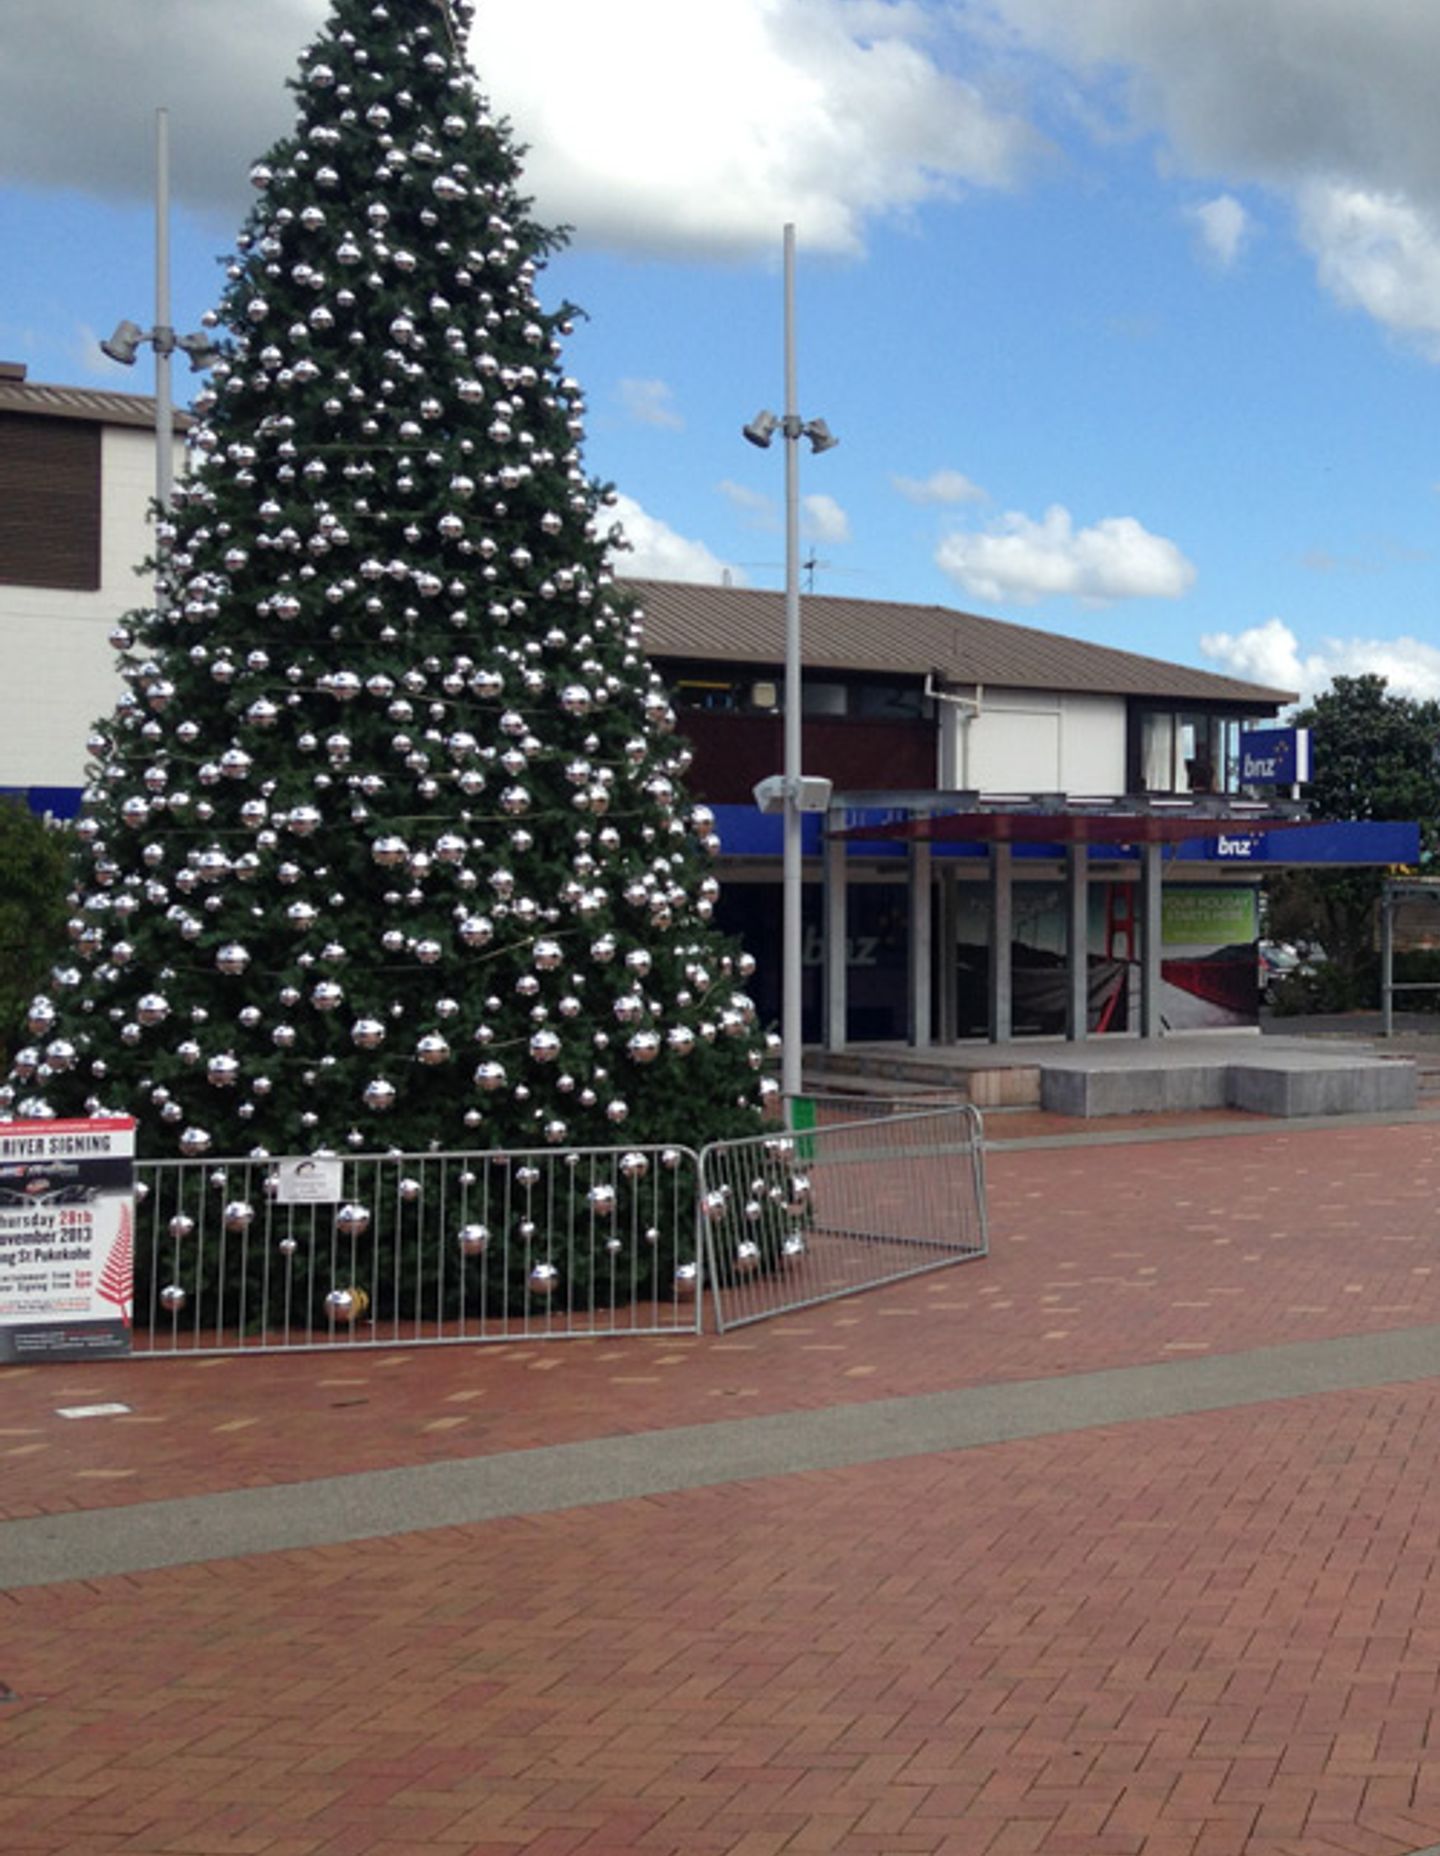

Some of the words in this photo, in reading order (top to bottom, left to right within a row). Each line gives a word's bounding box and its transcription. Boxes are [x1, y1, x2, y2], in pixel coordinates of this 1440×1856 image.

[1244, 754, 1276, 778] bnz
[1217, 834, 1252, 856] bnz
[49, 1135, 111, 1154] SIGNING
[59, 1210, 93, 1226] 28th
[60, 1227, 92, 1243] 2013
[34, 1246, 91, 1263] Pukekohe
